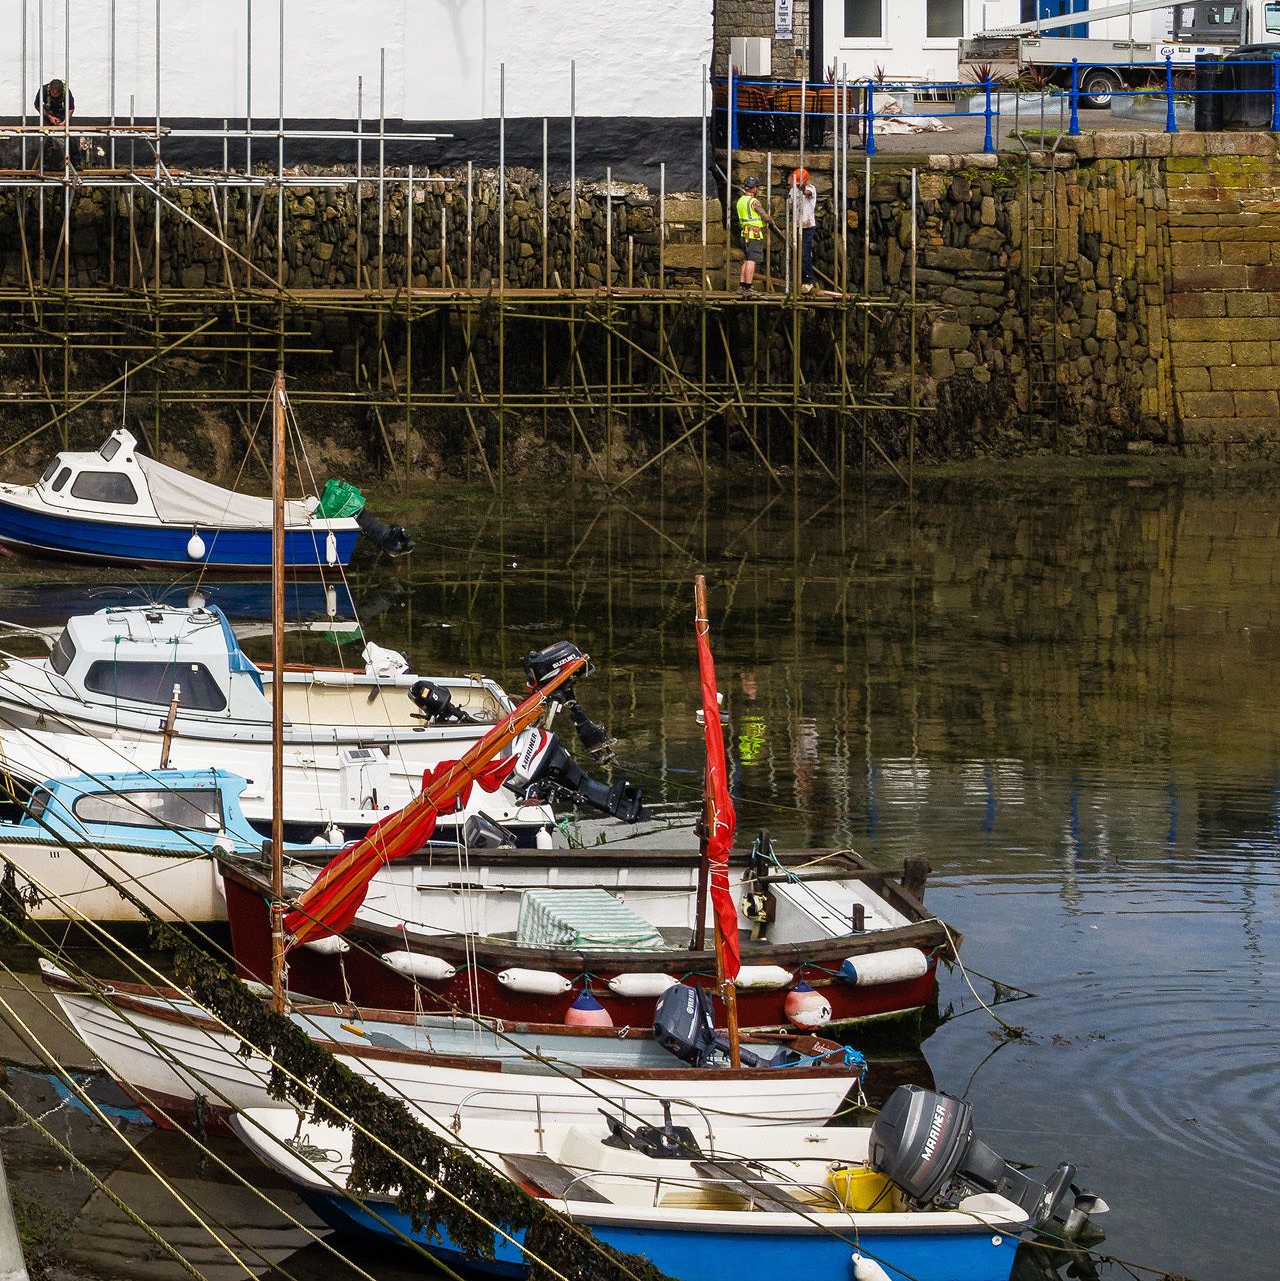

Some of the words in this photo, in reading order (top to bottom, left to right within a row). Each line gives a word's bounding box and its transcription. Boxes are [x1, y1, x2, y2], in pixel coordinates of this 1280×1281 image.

[552, 653, 580, 669] SUZUKI
[521, 732, 537, 770] MARINER
[921, 1104, 946, 1161] MARINER
